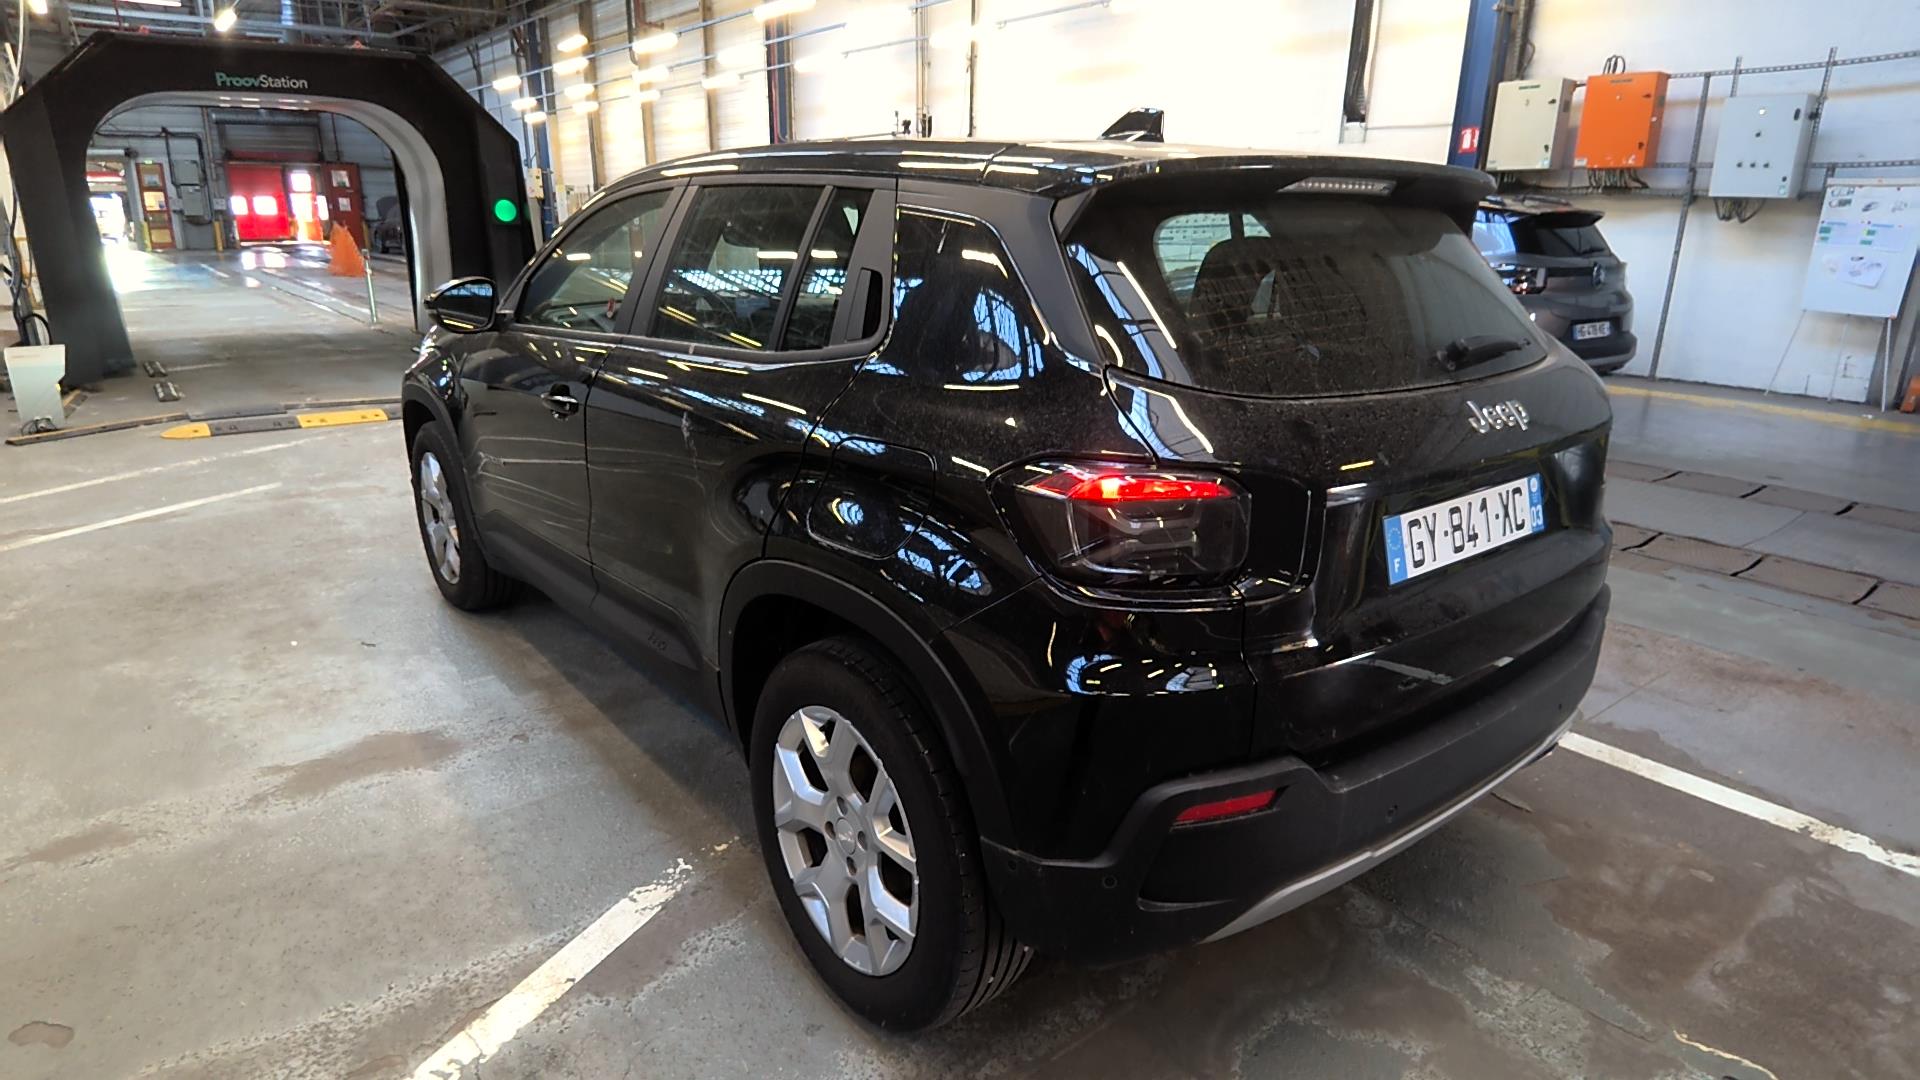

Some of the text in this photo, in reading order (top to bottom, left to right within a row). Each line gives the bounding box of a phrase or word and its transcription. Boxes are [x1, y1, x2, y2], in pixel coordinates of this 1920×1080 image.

[215, 71, 309, 89] ProovStation
[1466, 400, 1530, 434] Jeep
[1530, 505, 1544, 527] 03
[1393, 558, 1401, 574] F
